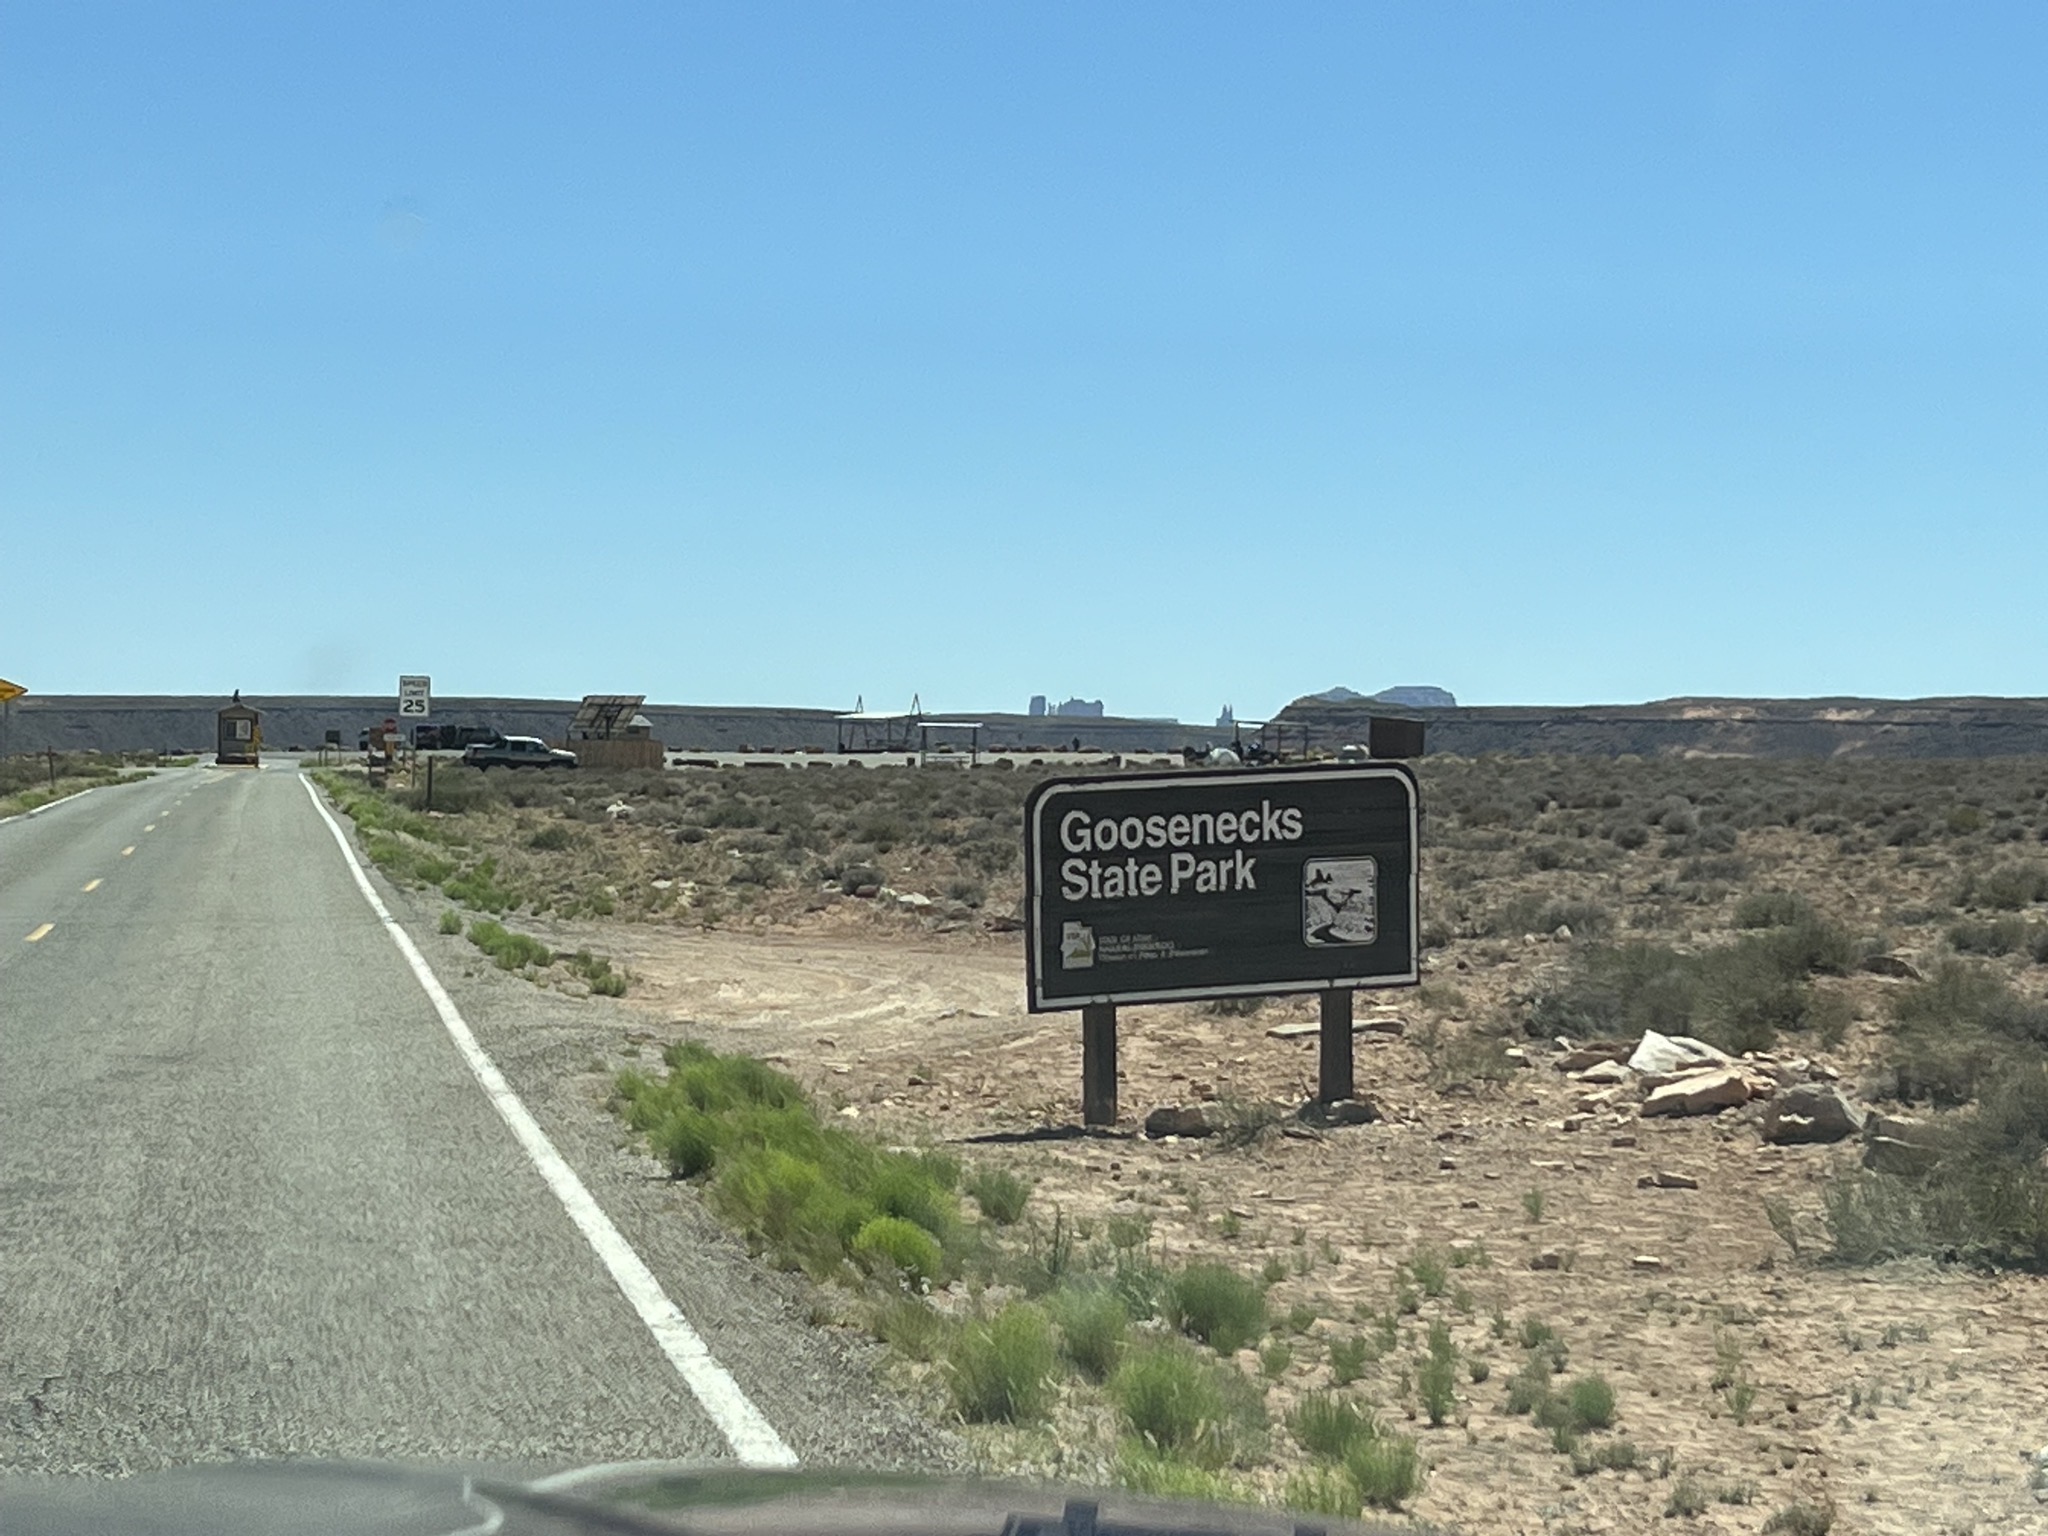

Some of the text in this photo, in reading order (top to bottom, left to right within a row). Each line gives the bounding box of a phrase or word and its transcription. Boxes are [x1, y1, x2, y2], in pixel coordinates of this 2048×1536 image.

[403, 699, 425, 713] 25
[1060, 800, 1304, 853] Goosenecks
[1060, 850, 1256, 901] State Park
